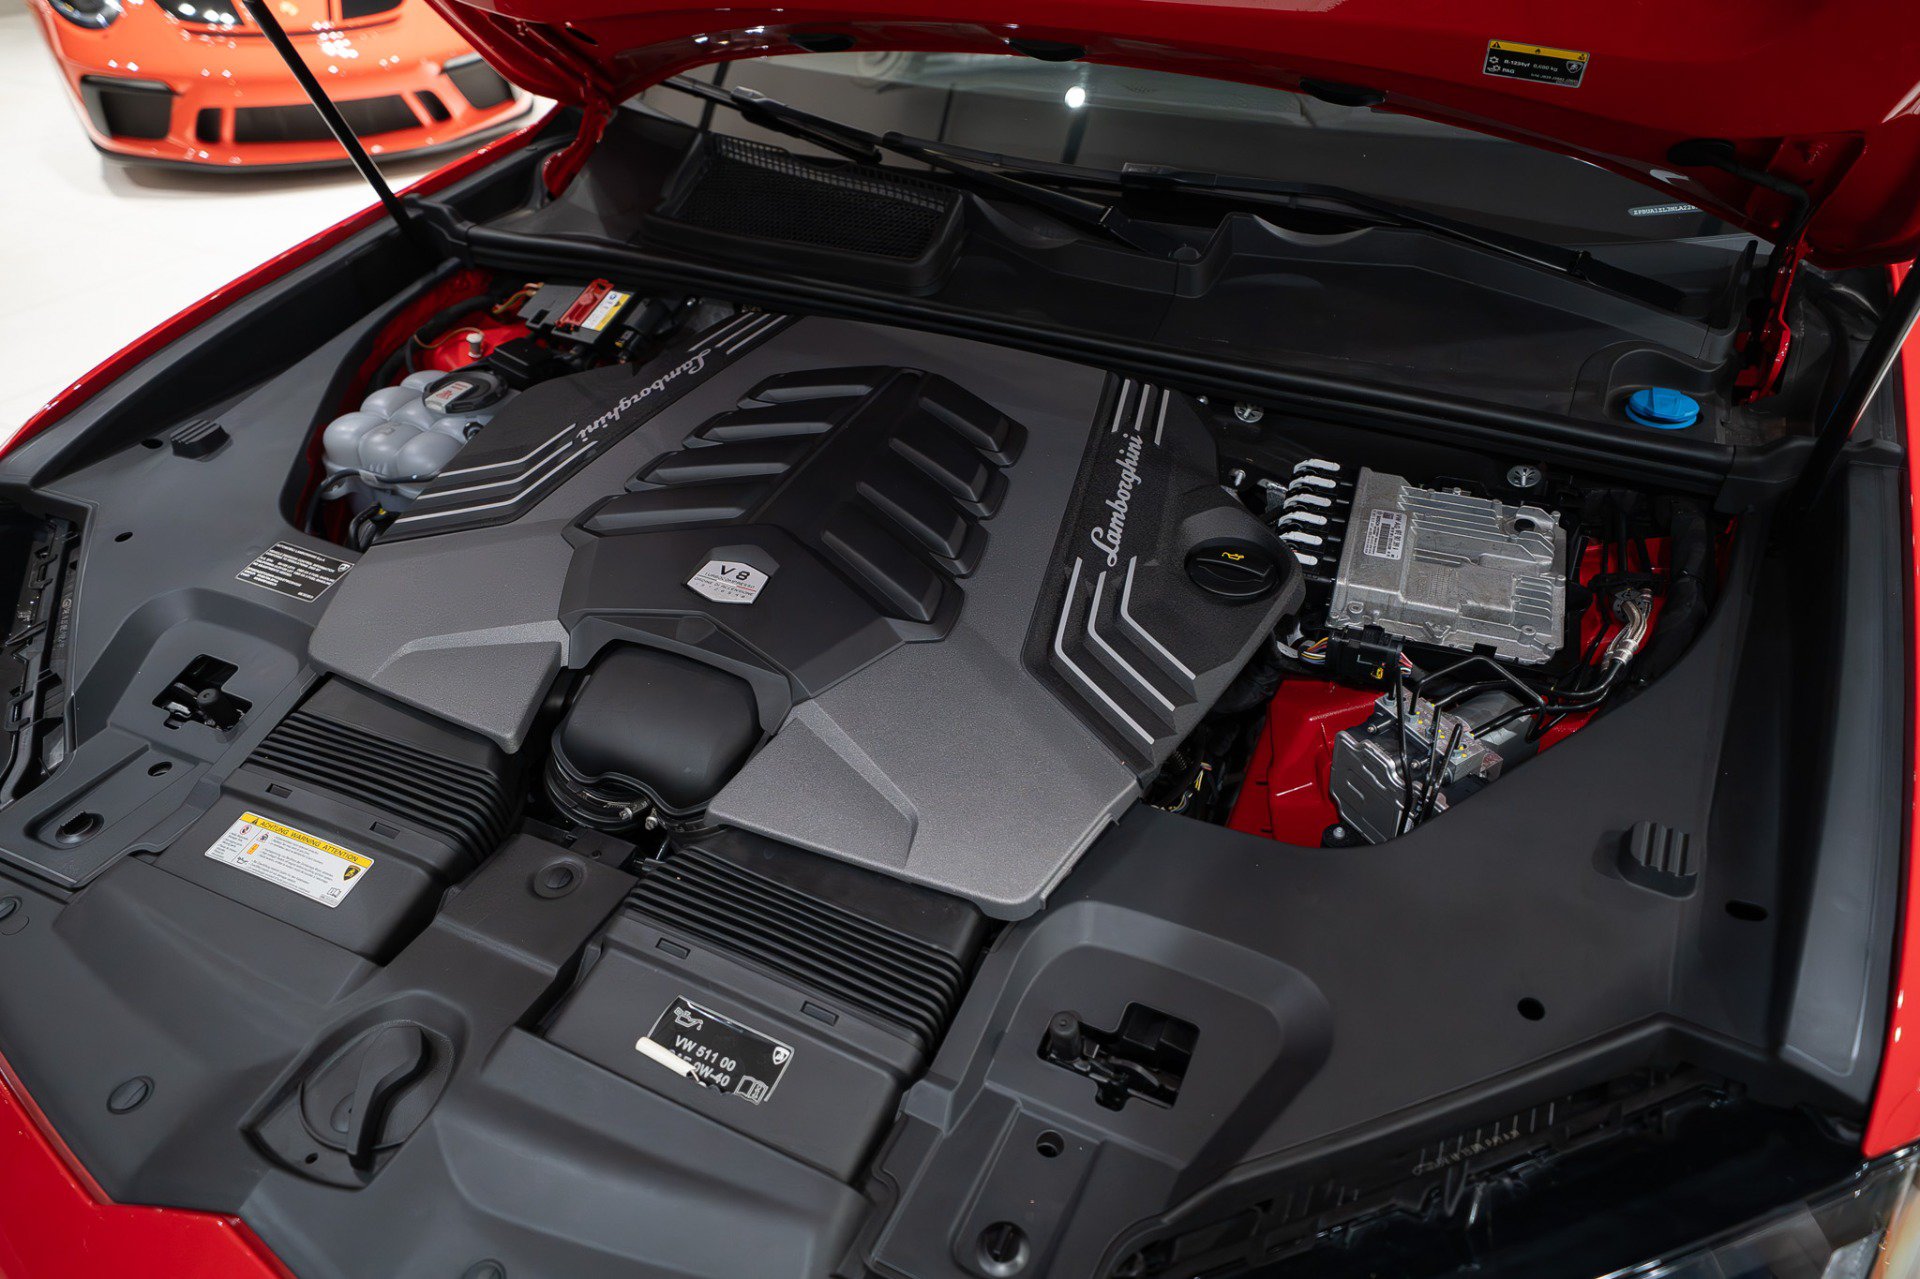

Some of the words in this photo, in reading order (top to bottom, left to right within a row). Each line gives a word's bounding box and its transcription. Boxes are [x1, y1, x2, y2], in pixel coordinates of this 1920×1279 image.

[576, 348, 712, 442] Lamborghini
[1090, 432, 1144, 567] Lamborghini
[261, 821, 290, 836] ACHTUNG
[290, 832, 321, 848] WARNING
[322, 843, 359, 863] ATTENTION
[674, 1034, 697, 1053] VW
[695, 1046, 719, 1064] 511
[719, 1056, 737, 1072] 00
